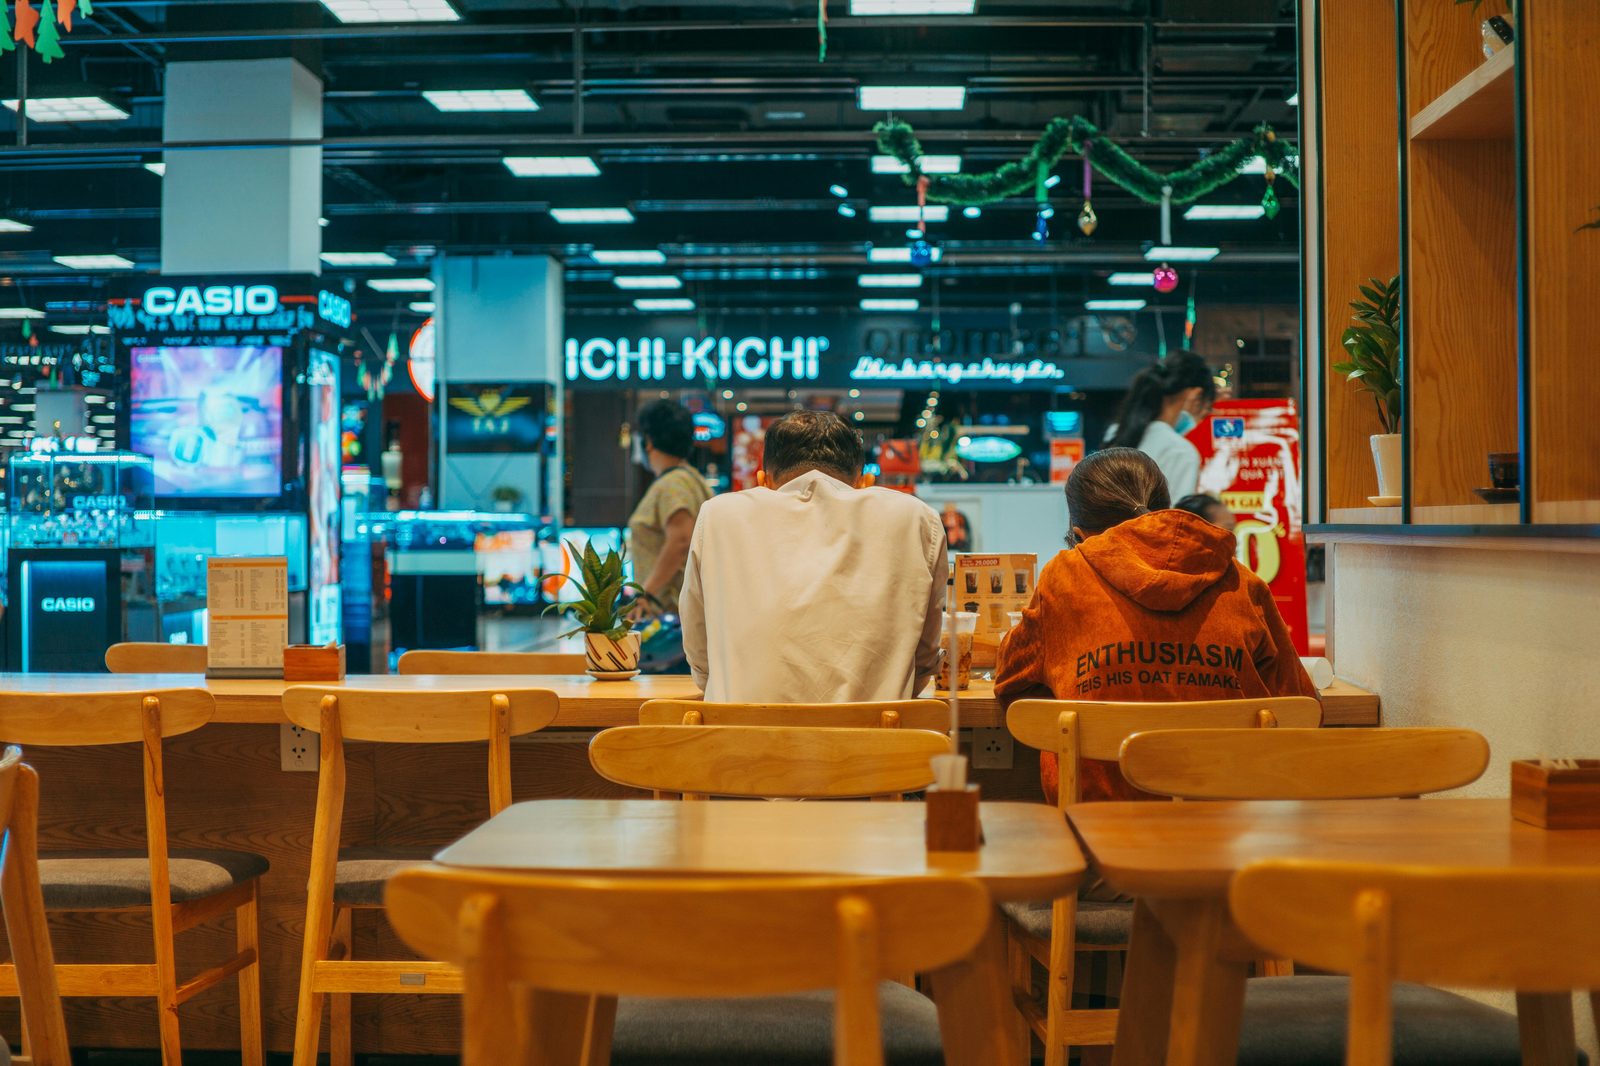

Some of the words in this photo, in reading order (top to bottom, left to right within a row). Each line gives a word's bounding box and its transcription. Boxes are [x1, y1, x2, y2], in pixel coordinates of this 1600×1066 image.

[143, 286, 278, 316] CASIO
[72, 495, 126, 509] CASIO
[41, 597, 95, 612] CASIO
[1076, 640, 1244, 679] ENTHUSIASM
[1076, 676, 1101, 696] TEIS
[1106, 670, 1133, 687] HIS
[1138, 670, 1172, 685] OAT
